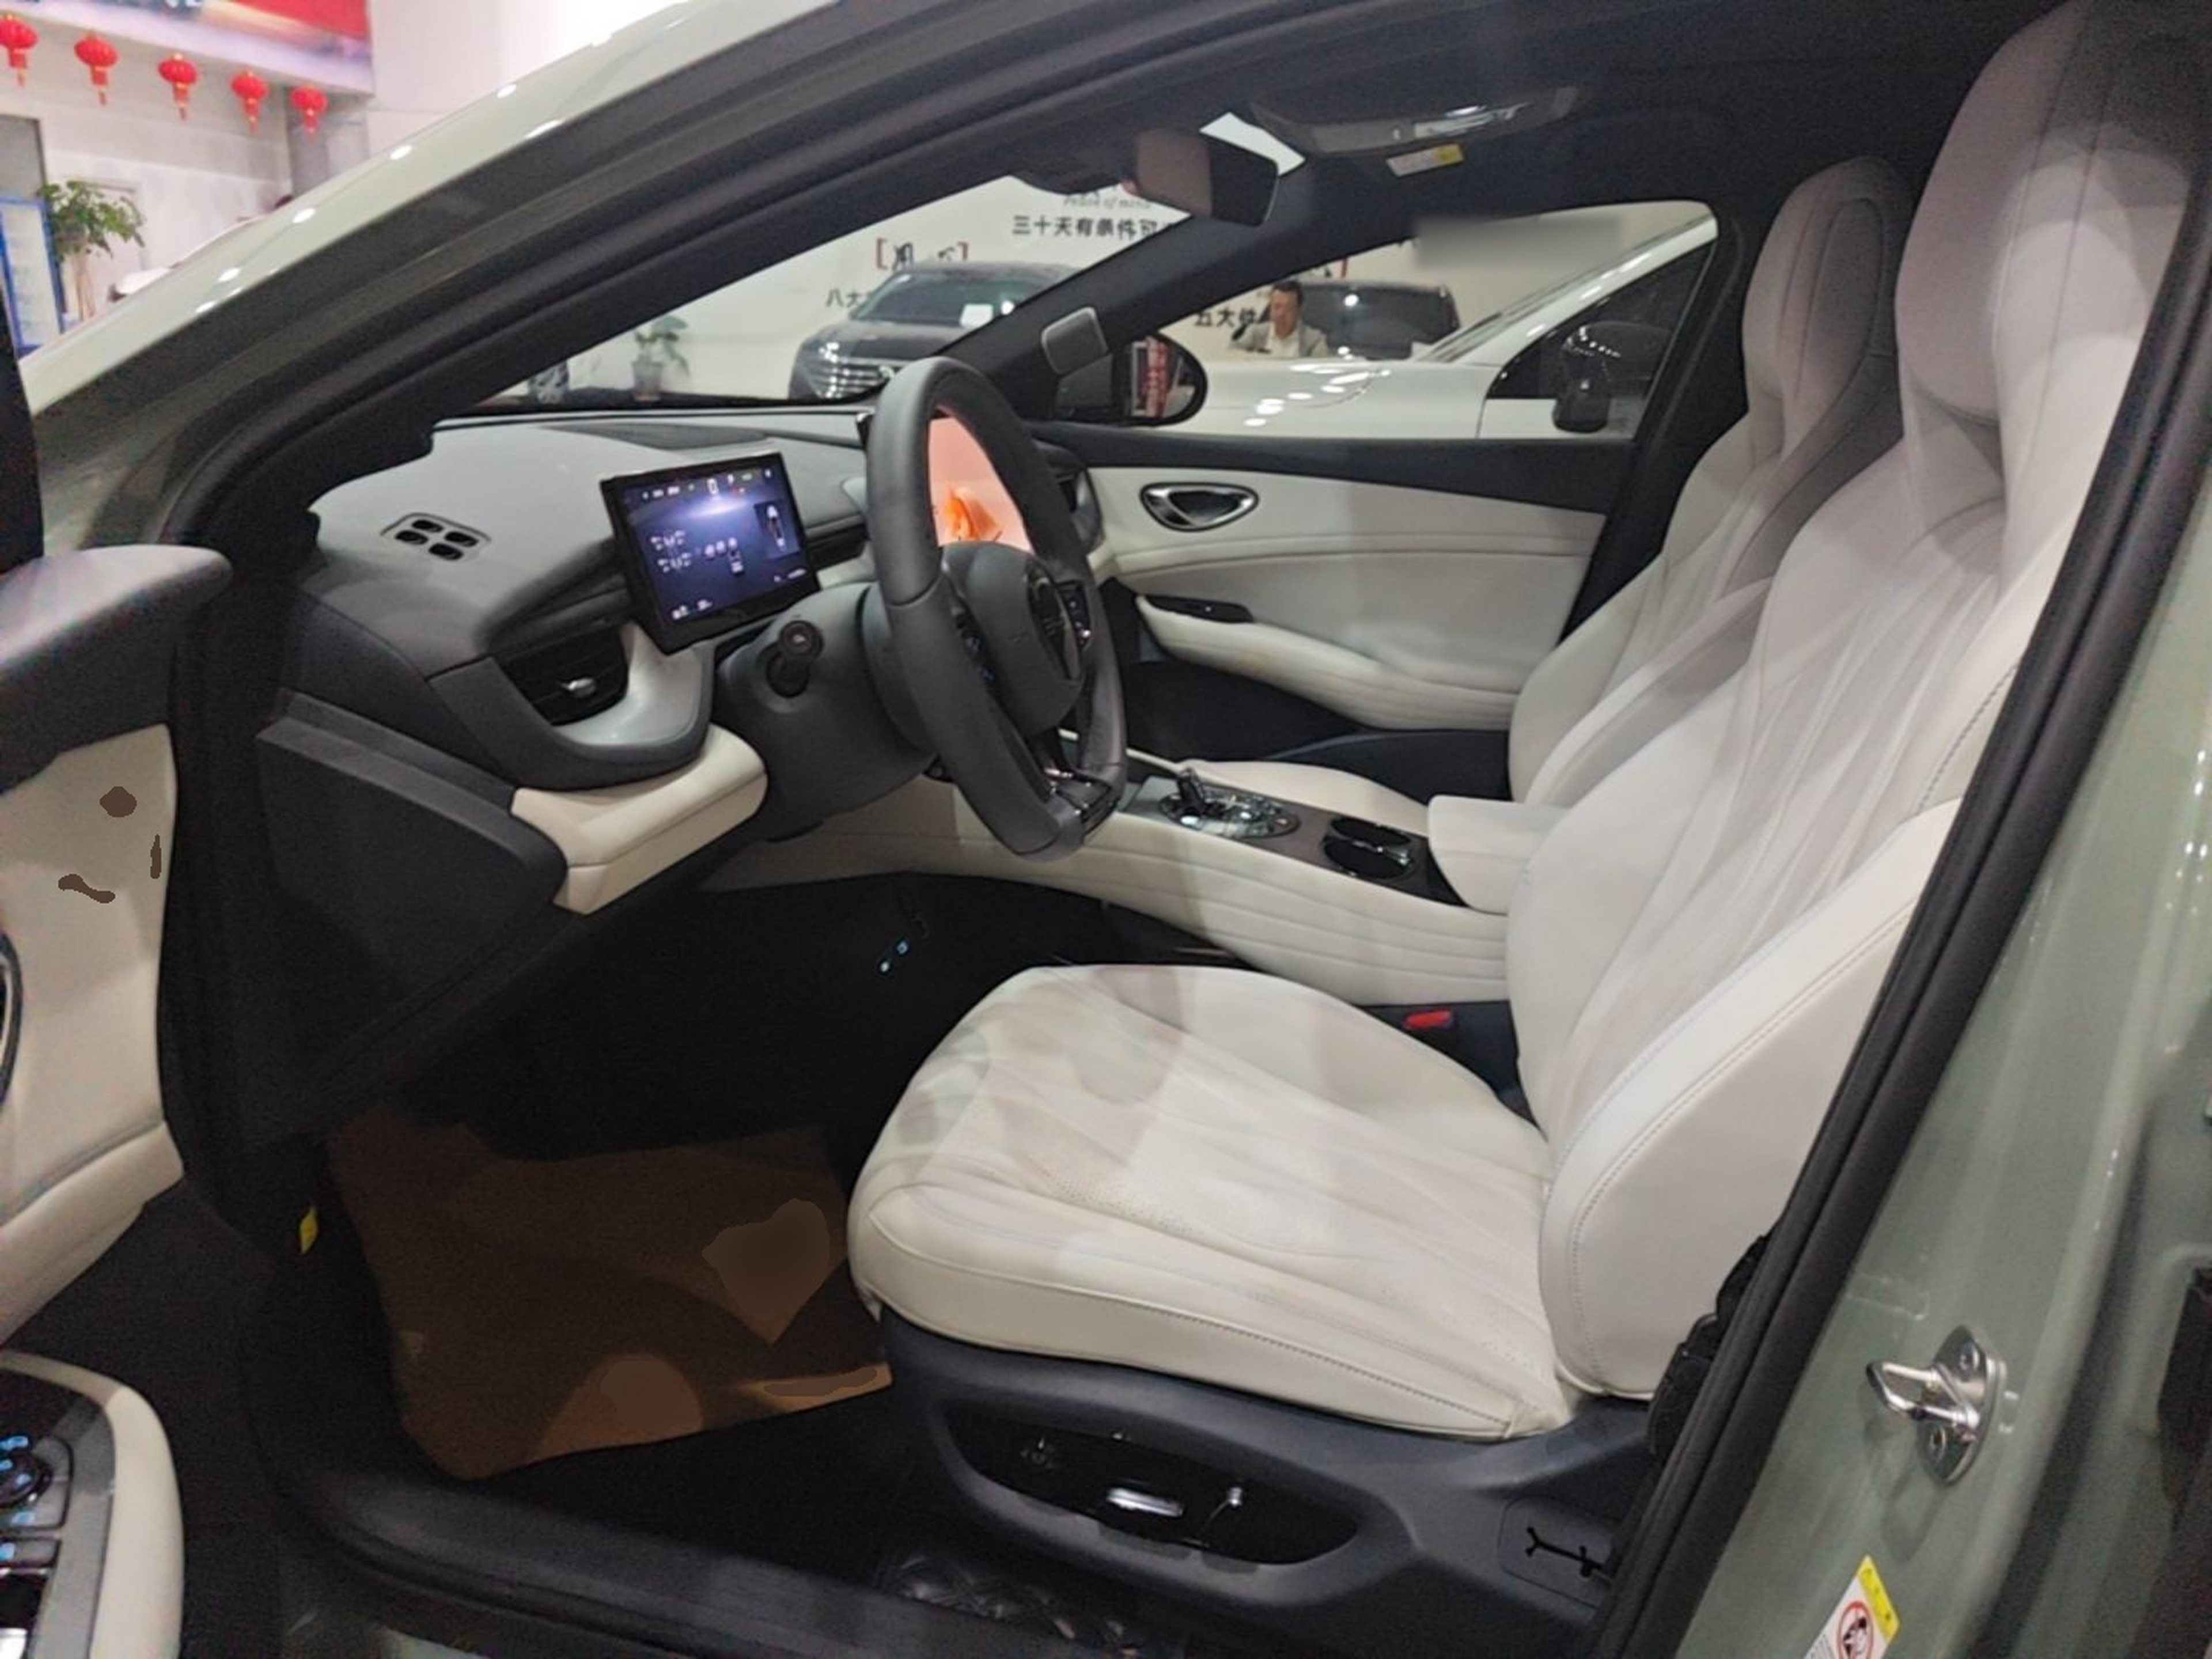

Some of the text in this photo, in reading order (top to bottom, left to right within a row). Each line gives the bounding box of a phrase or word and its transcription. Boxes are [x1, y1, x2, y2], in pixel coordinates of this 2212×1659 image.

[1012, 215, 1167, 240] 三十天有条件可
[825, 289, 869, 308] 八大
